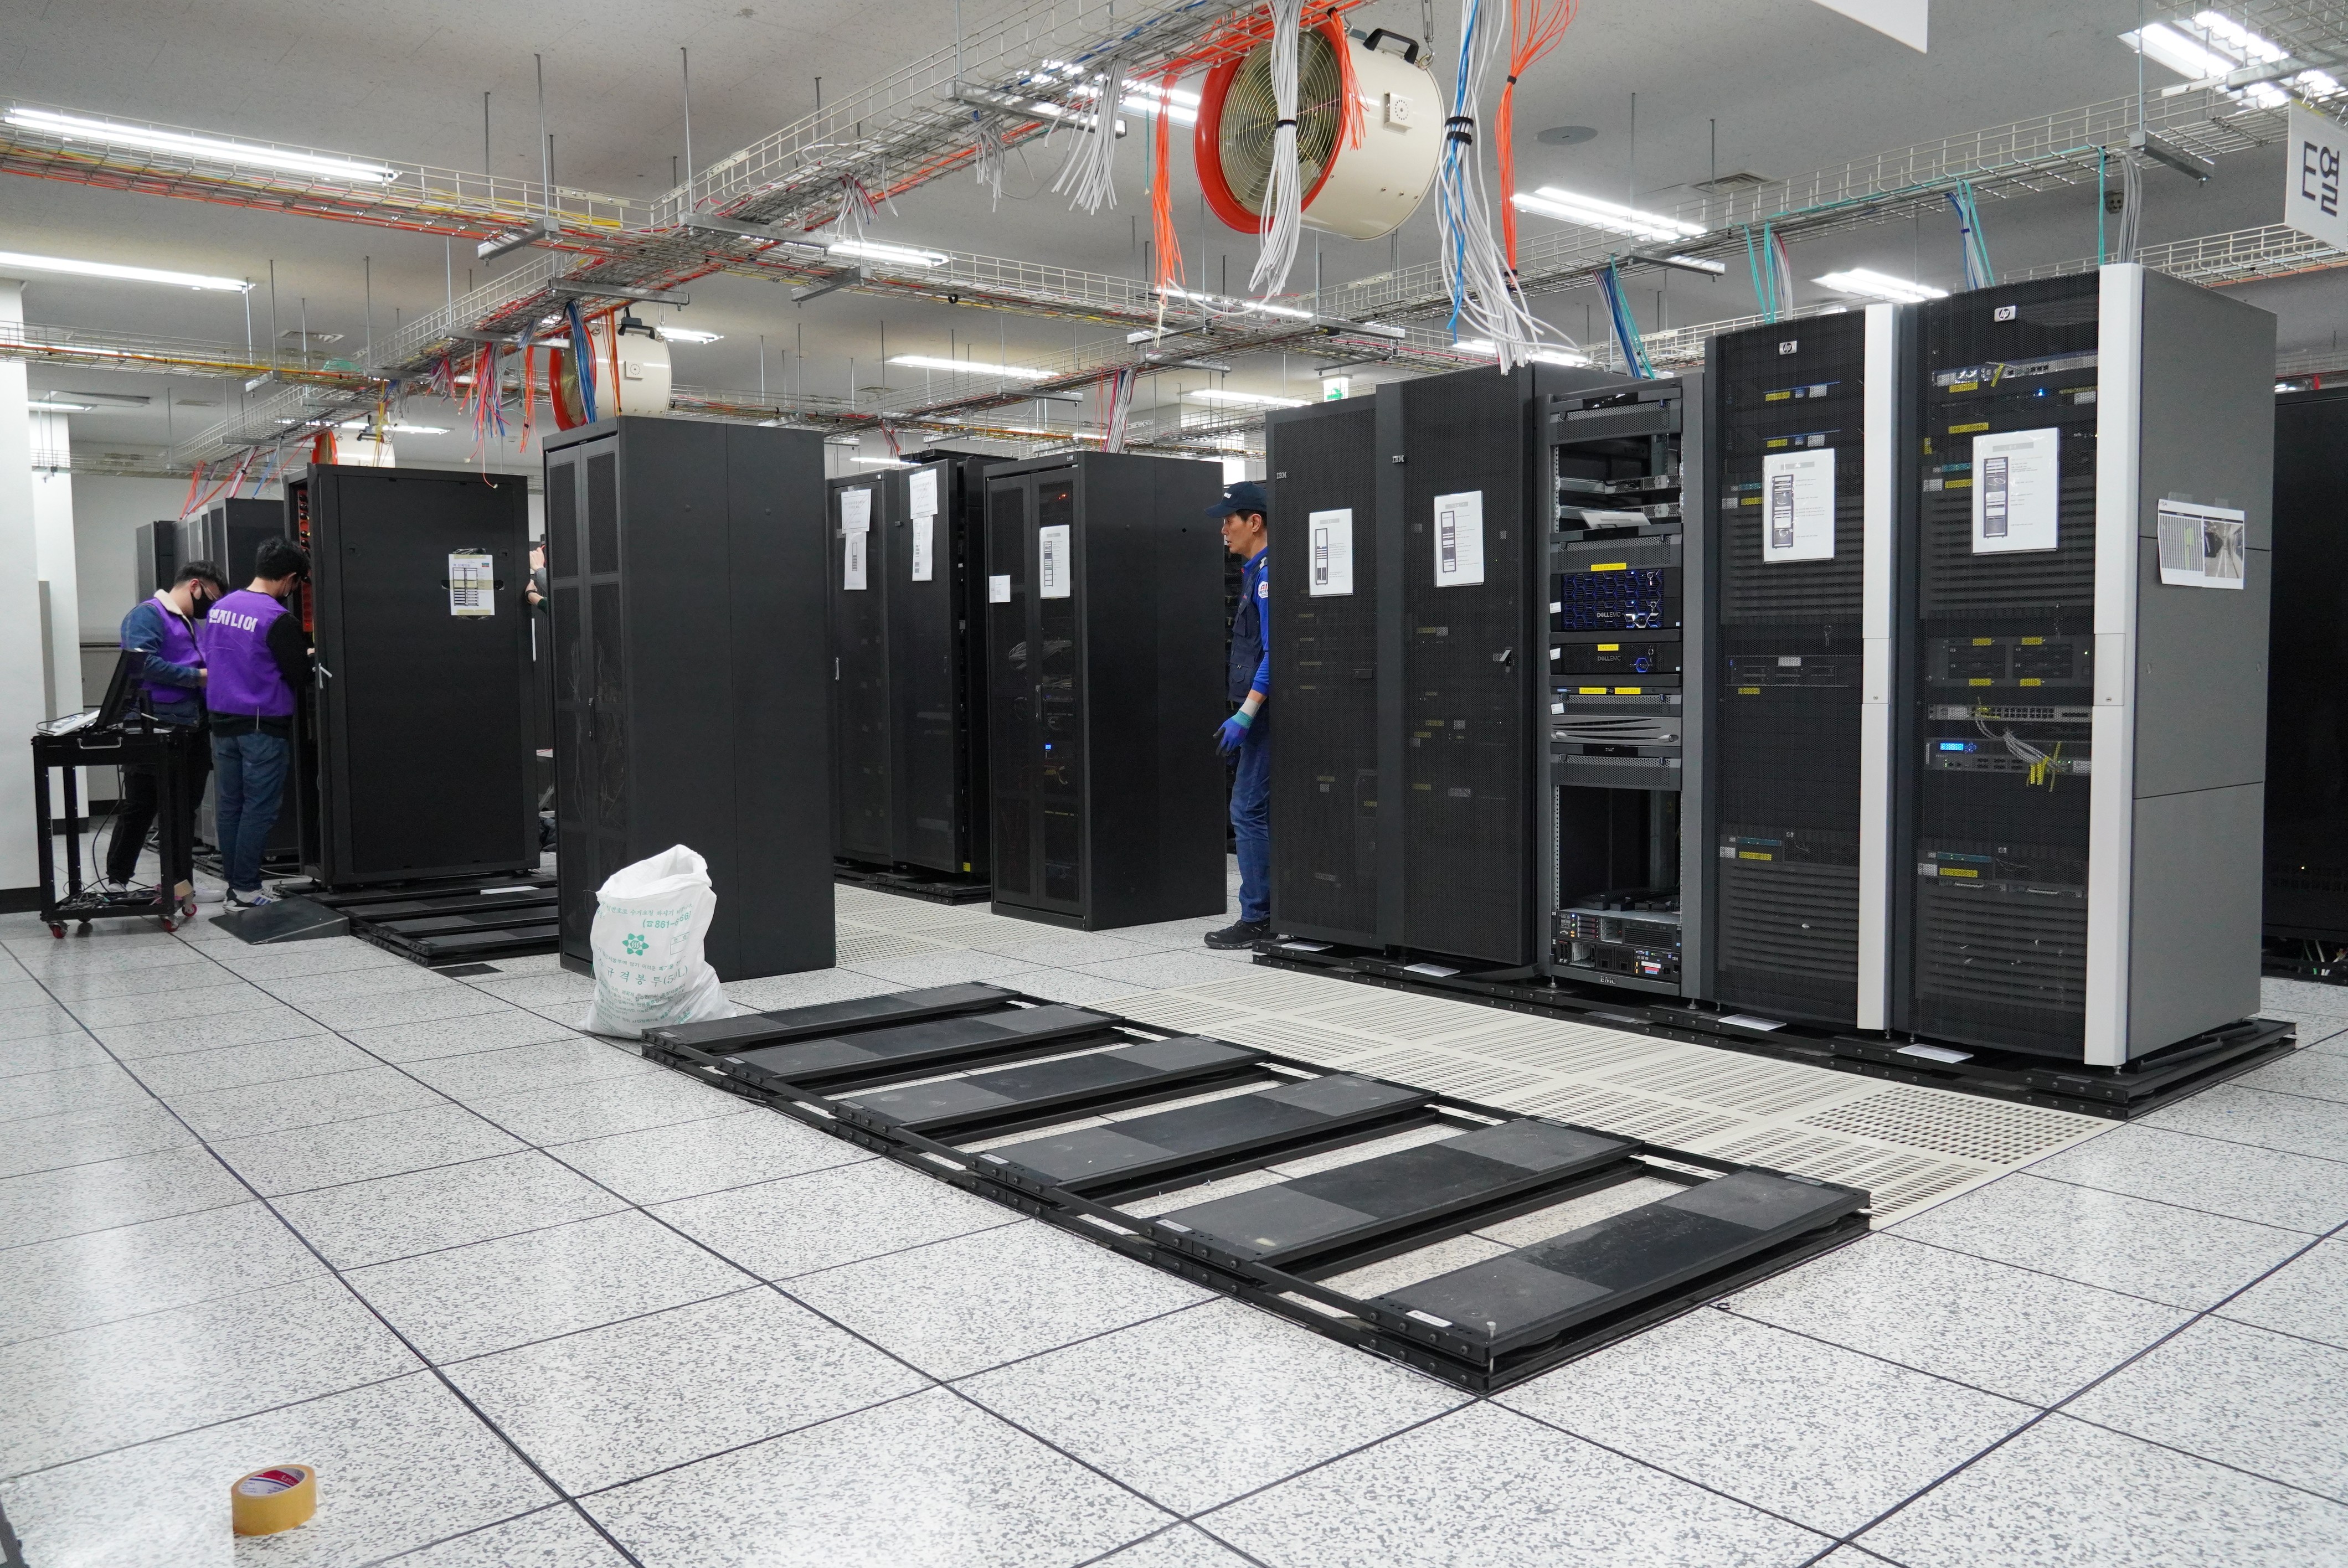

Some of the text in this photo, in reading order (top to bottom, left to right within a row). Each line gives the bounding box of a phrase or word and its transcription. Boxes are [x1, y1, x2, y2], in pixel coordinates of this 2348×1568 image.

[1392, 455, 1404, 463] IBM
[208, 608, 259, 632] 엔지니어
[1600, 976, 1616, 985] EMC
